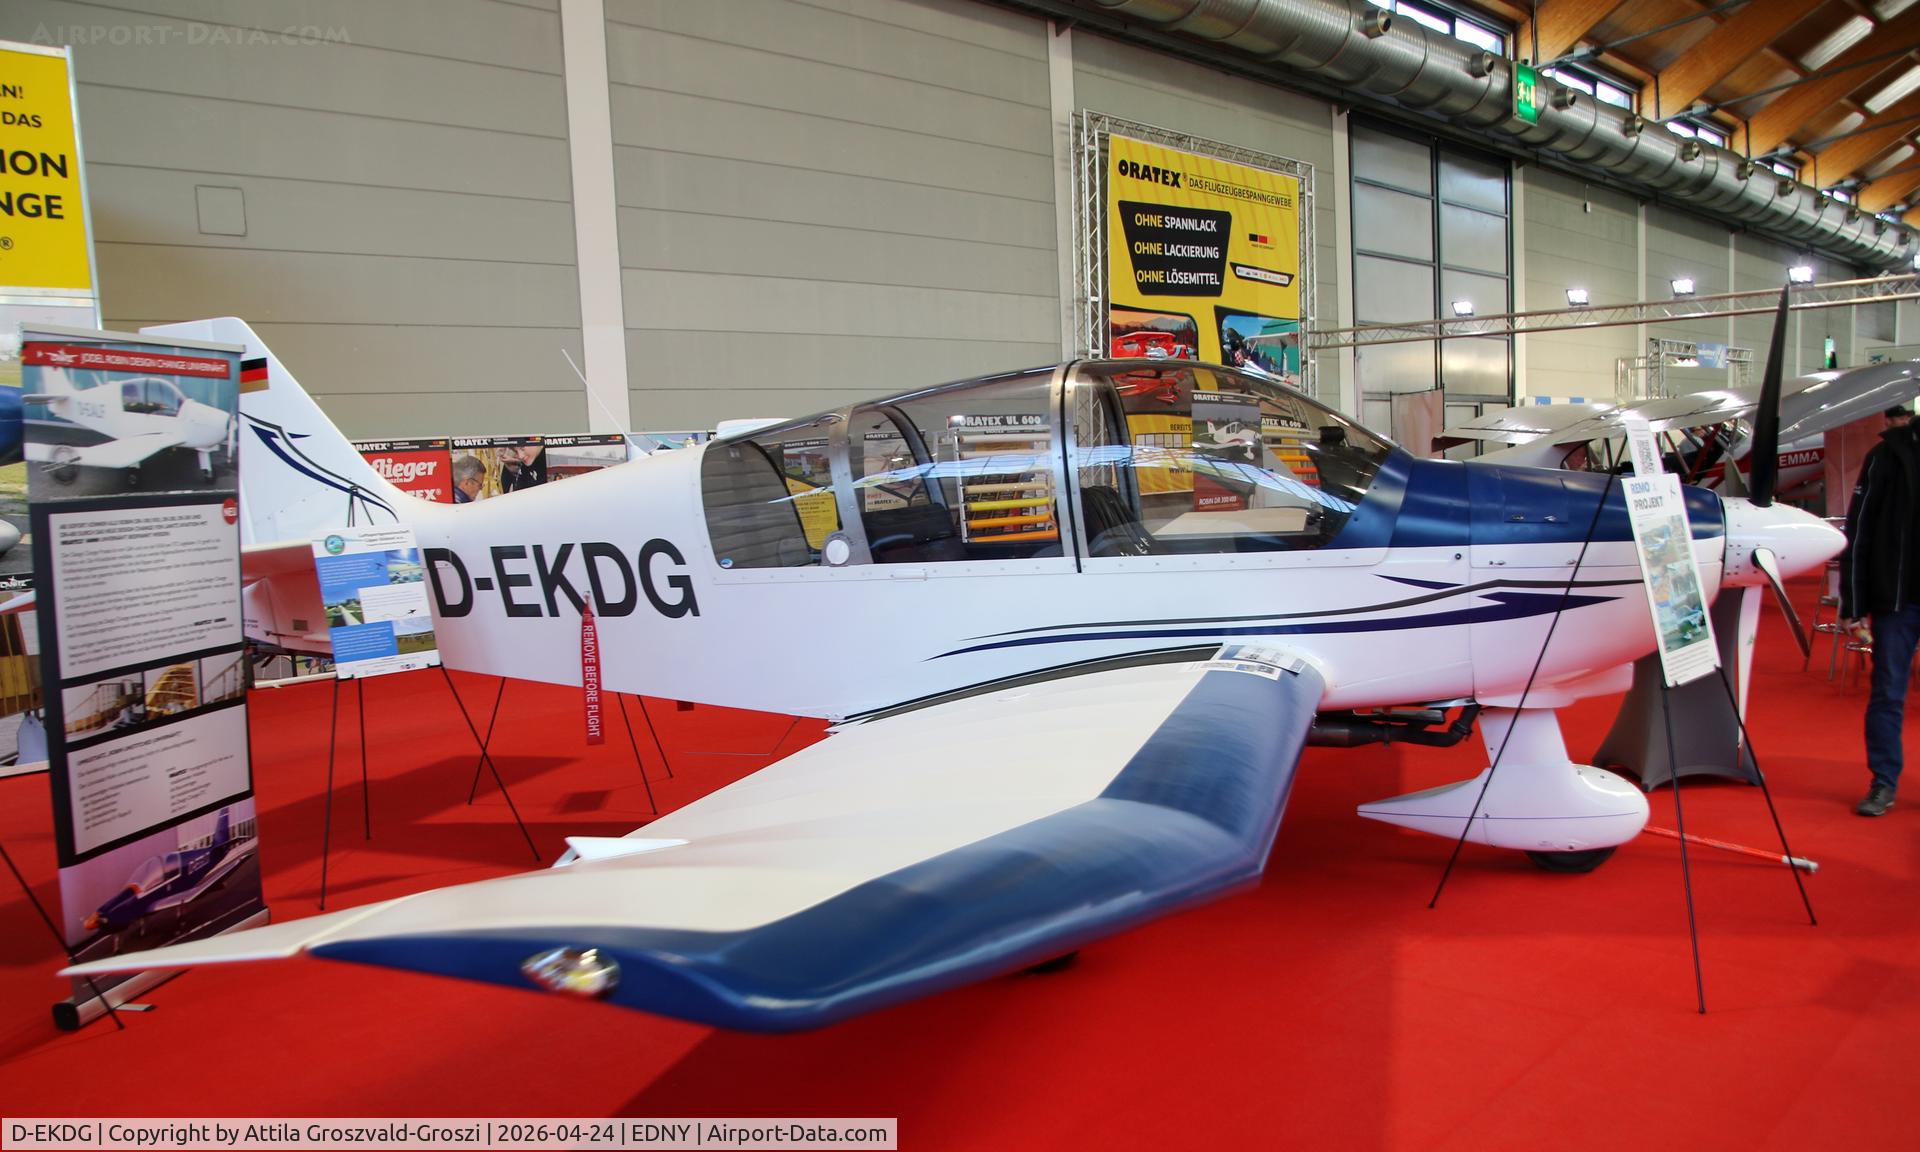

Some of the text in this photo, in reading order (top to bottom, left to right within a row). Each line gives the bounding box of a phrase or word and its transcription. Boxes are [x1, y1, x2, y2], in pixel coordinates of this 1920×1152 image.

[0, 84, 24, 99] N!
[2, 111, 42, 128] DAS
[1189, 177, 1203, 190] DAS
[1205, 181, 1292, 208] FLUGZEUGBESPANNGEWEBE
[1135, 213, 1217, 232] OHNE SPANNLACK
[1134, 243, 1219, 259] OHNE LACKIERUNG
[1136, 270, 1164, 283] OHNE
[1166, 268, 1220, 285] LÖSEMITTEL
[1022, 415, 1041, 425] 600
[1778, 451, 1820, 467] EMMA
[1630, 482, 1650, 494] REMO
[1633, 496, 1664, 511] PROJEKT
[423, 538, 700, 618] D-EKDG
[583, 624, 600, 737] REMOVE BEFORE FLIGHT
